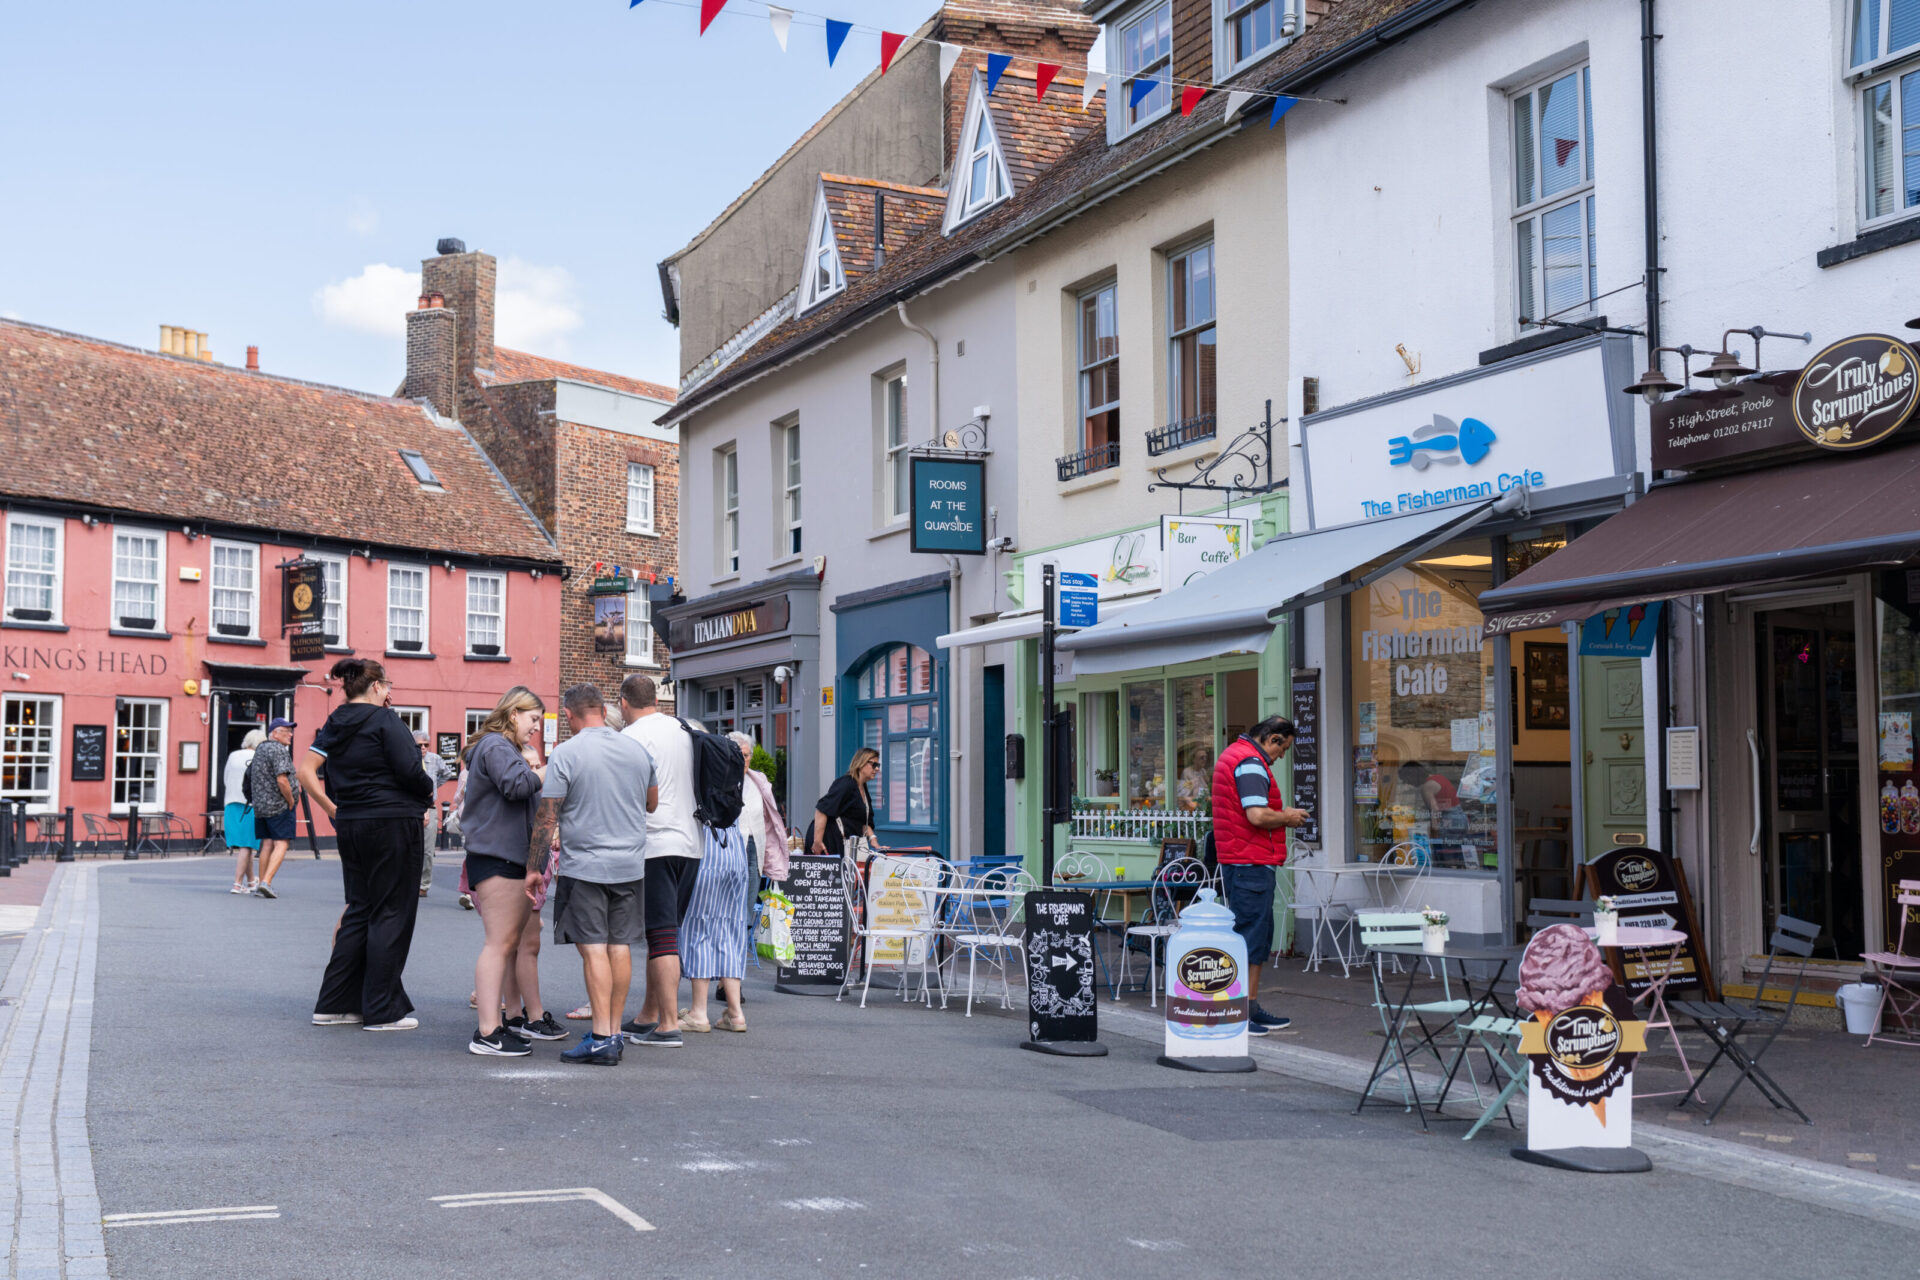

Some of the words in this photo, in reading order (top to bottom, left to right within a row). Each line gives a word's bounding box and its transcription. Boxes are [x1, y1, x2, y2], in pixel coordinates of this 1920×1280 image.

[1820, 357, 1876, 392] Truly
[1812, 372, 1912, 425] Scrumptious
[1669, 418, 1675, 430] 5
[1677, 411, 1705, 429] High
[1705, 405, 1739, 422] Street,
[1742, 396, 1774, 413] Poole
[1668, 433, 1710, 449] Telephone
[1713, 424, 1739, 439] 01202
[1741, 417, 1774, 432] 674117
[929, 480, 967, 491] ROOMS
[1361, 500, 1392, 518] The
[1397, 481, 1492, 512] Fisherman
[1498, 469, 1544, 493] Cafe
[930, 500, 942, 510] AT
[947, 501, 966, 511] THE
[924, 520, 974, 532] QUAYSIDE
[1178, 532, 1197, 543] Bar
[1400, 587, 1442, 620] The
[1485, 610, 1556, 634] SWEETS
[293, 636, 321, 646] ALEHOUSE
[1362, 624, 1483, 661] Fisherman
[297, 646, 323, 655] KITCHEN
[3, 645, 87, 672] KINGS
[97, 651, 168, 676] HEAD
[1396, 662, 1448, 697] Cafe
[788, 862, 799, 870] THE
[801, 862, 839, 871] FISHERMAN'S
[1622, 861, 1643, 873] Truly
[805, 871, 821, 879] CAFE
[1621, 868, 1656, 883] Scrumptious
[1035, 904, 1047, 914] THE
[1048, 903, 1085, 915] FISHERMAN'S
[1053, 914, 1069, 925] CAFE
[1640, 920, 1651, 928] 220
[1653, 918, 1668, 928] JARS!
[820, 928, 839, 936] VEGAN
[793, 953, 805, 961] AILY
[1655, 949, 1671, 957] from
[1191, 956, 1219, 970] Truly
[797, 968, 827, 976] WELCOME
[1187, 967, 1233, 982] Scrumptious
[1173, 1006, 1208, 1017] Traditional
[1209, 1009, 1226, 1017] sweet
[1227, 1007, 1241, 1017] shop
[1564, 1017, 1597, 1036] Truly
[1557, 1031, 1617, 1053] Scrumptious
[1542, 1063, 1584, 1097] Traditional
[1585, 1081, 1607, 1097] sweet
[1608, 1065, 1625, 1086] shop
